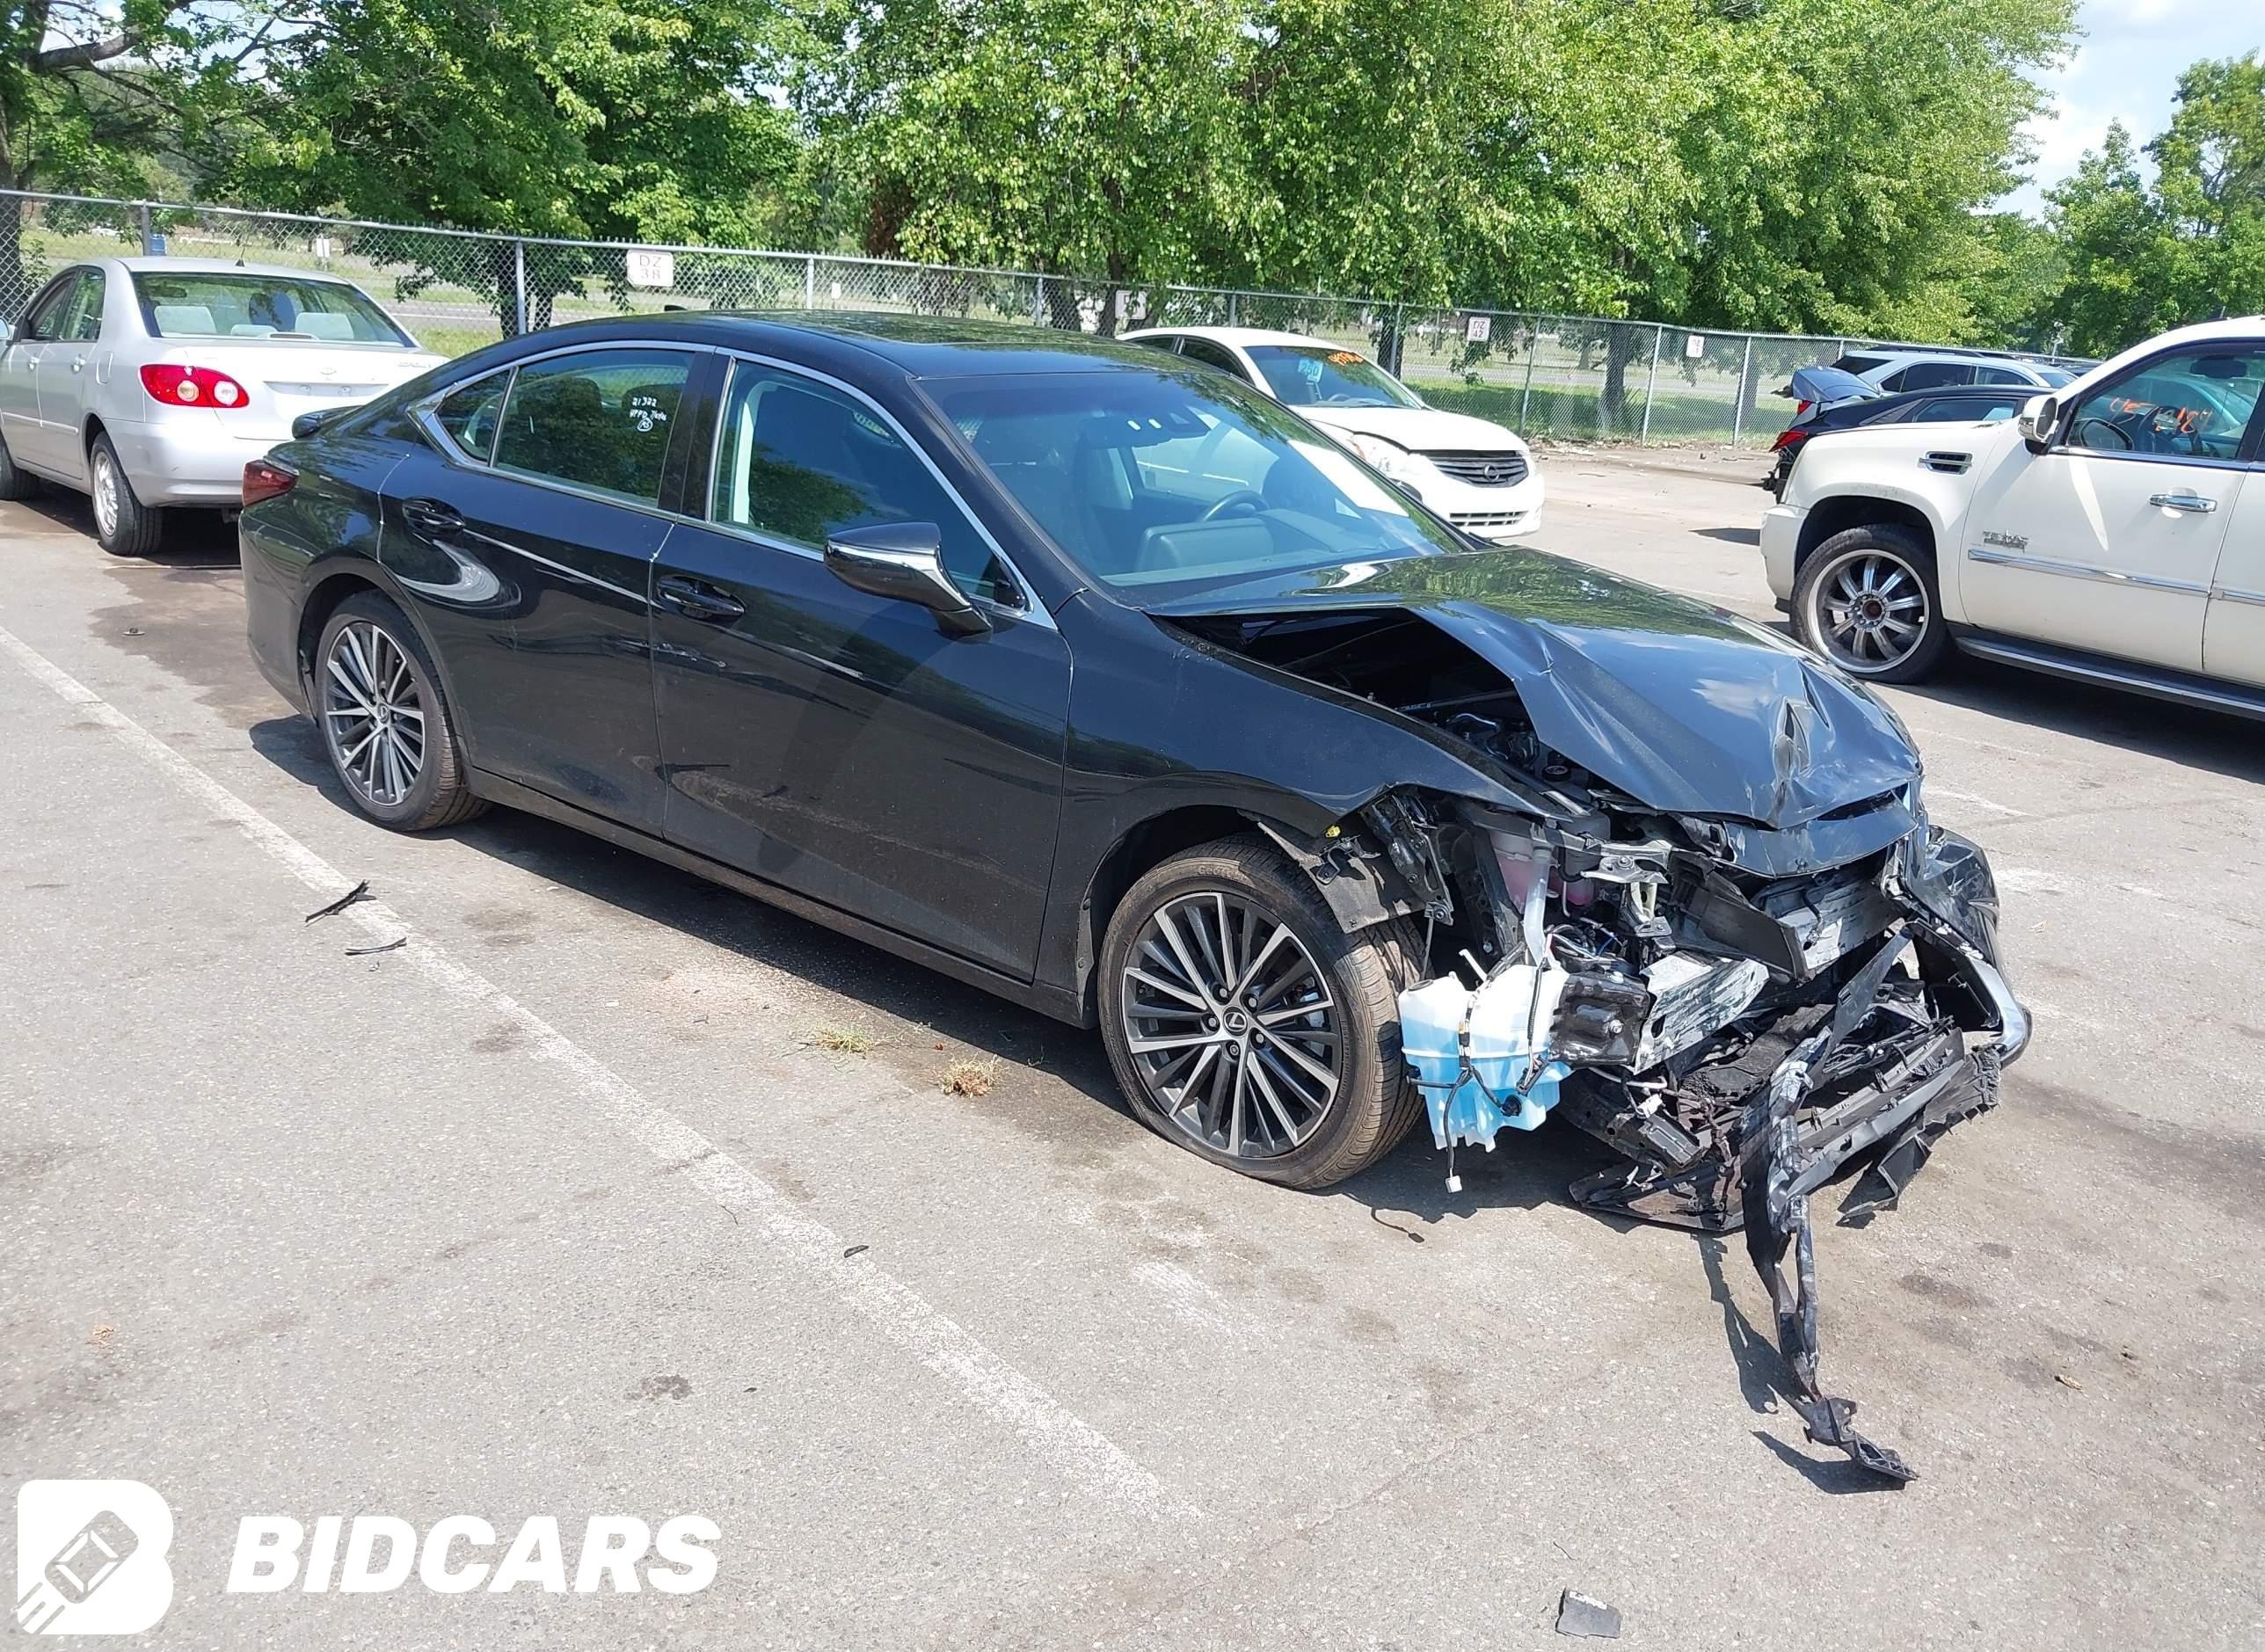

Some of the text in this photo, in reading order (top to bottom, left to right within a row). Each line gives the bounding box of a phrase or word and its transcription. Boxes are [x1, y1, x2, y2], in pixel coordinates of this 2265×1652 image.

[639, 254, 662, 267] DZ
[640, 268, 661, 280] 38
[1301, 362, 1319, 376] 250
